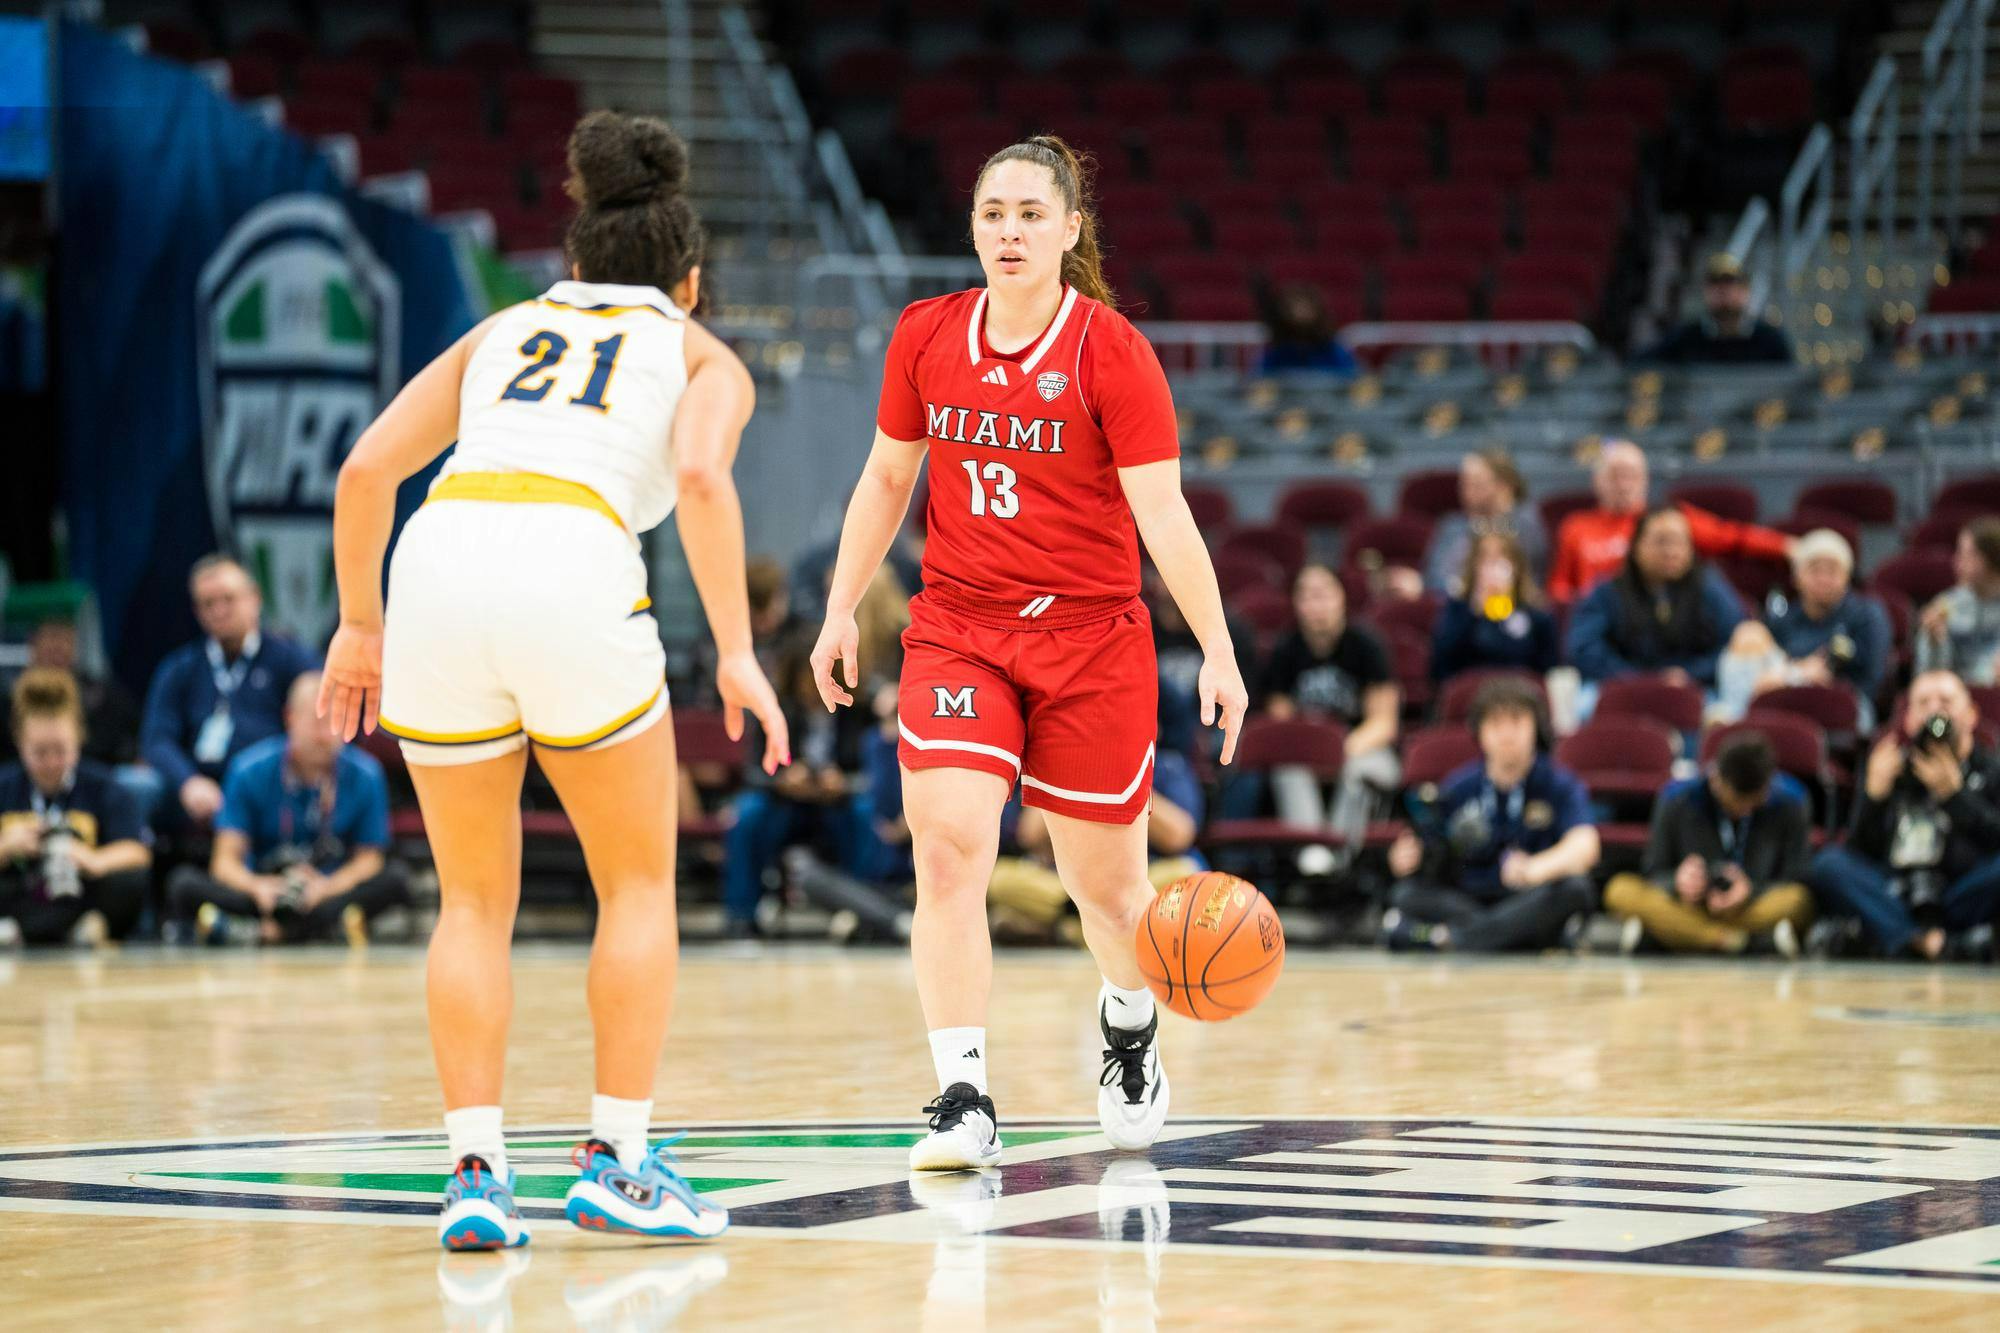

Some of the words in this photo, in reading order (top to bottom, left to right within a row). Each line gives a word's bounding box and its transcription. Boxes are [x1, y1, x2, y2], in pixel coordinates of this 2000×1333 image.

[498, 328, 629, 415] 21
[1038, 380, 1065, 390] MAC
[927, 402, 1067, 453] MIAMI
[960, 458, 1020, 519] 13
[931, 685, 980, 719] M
